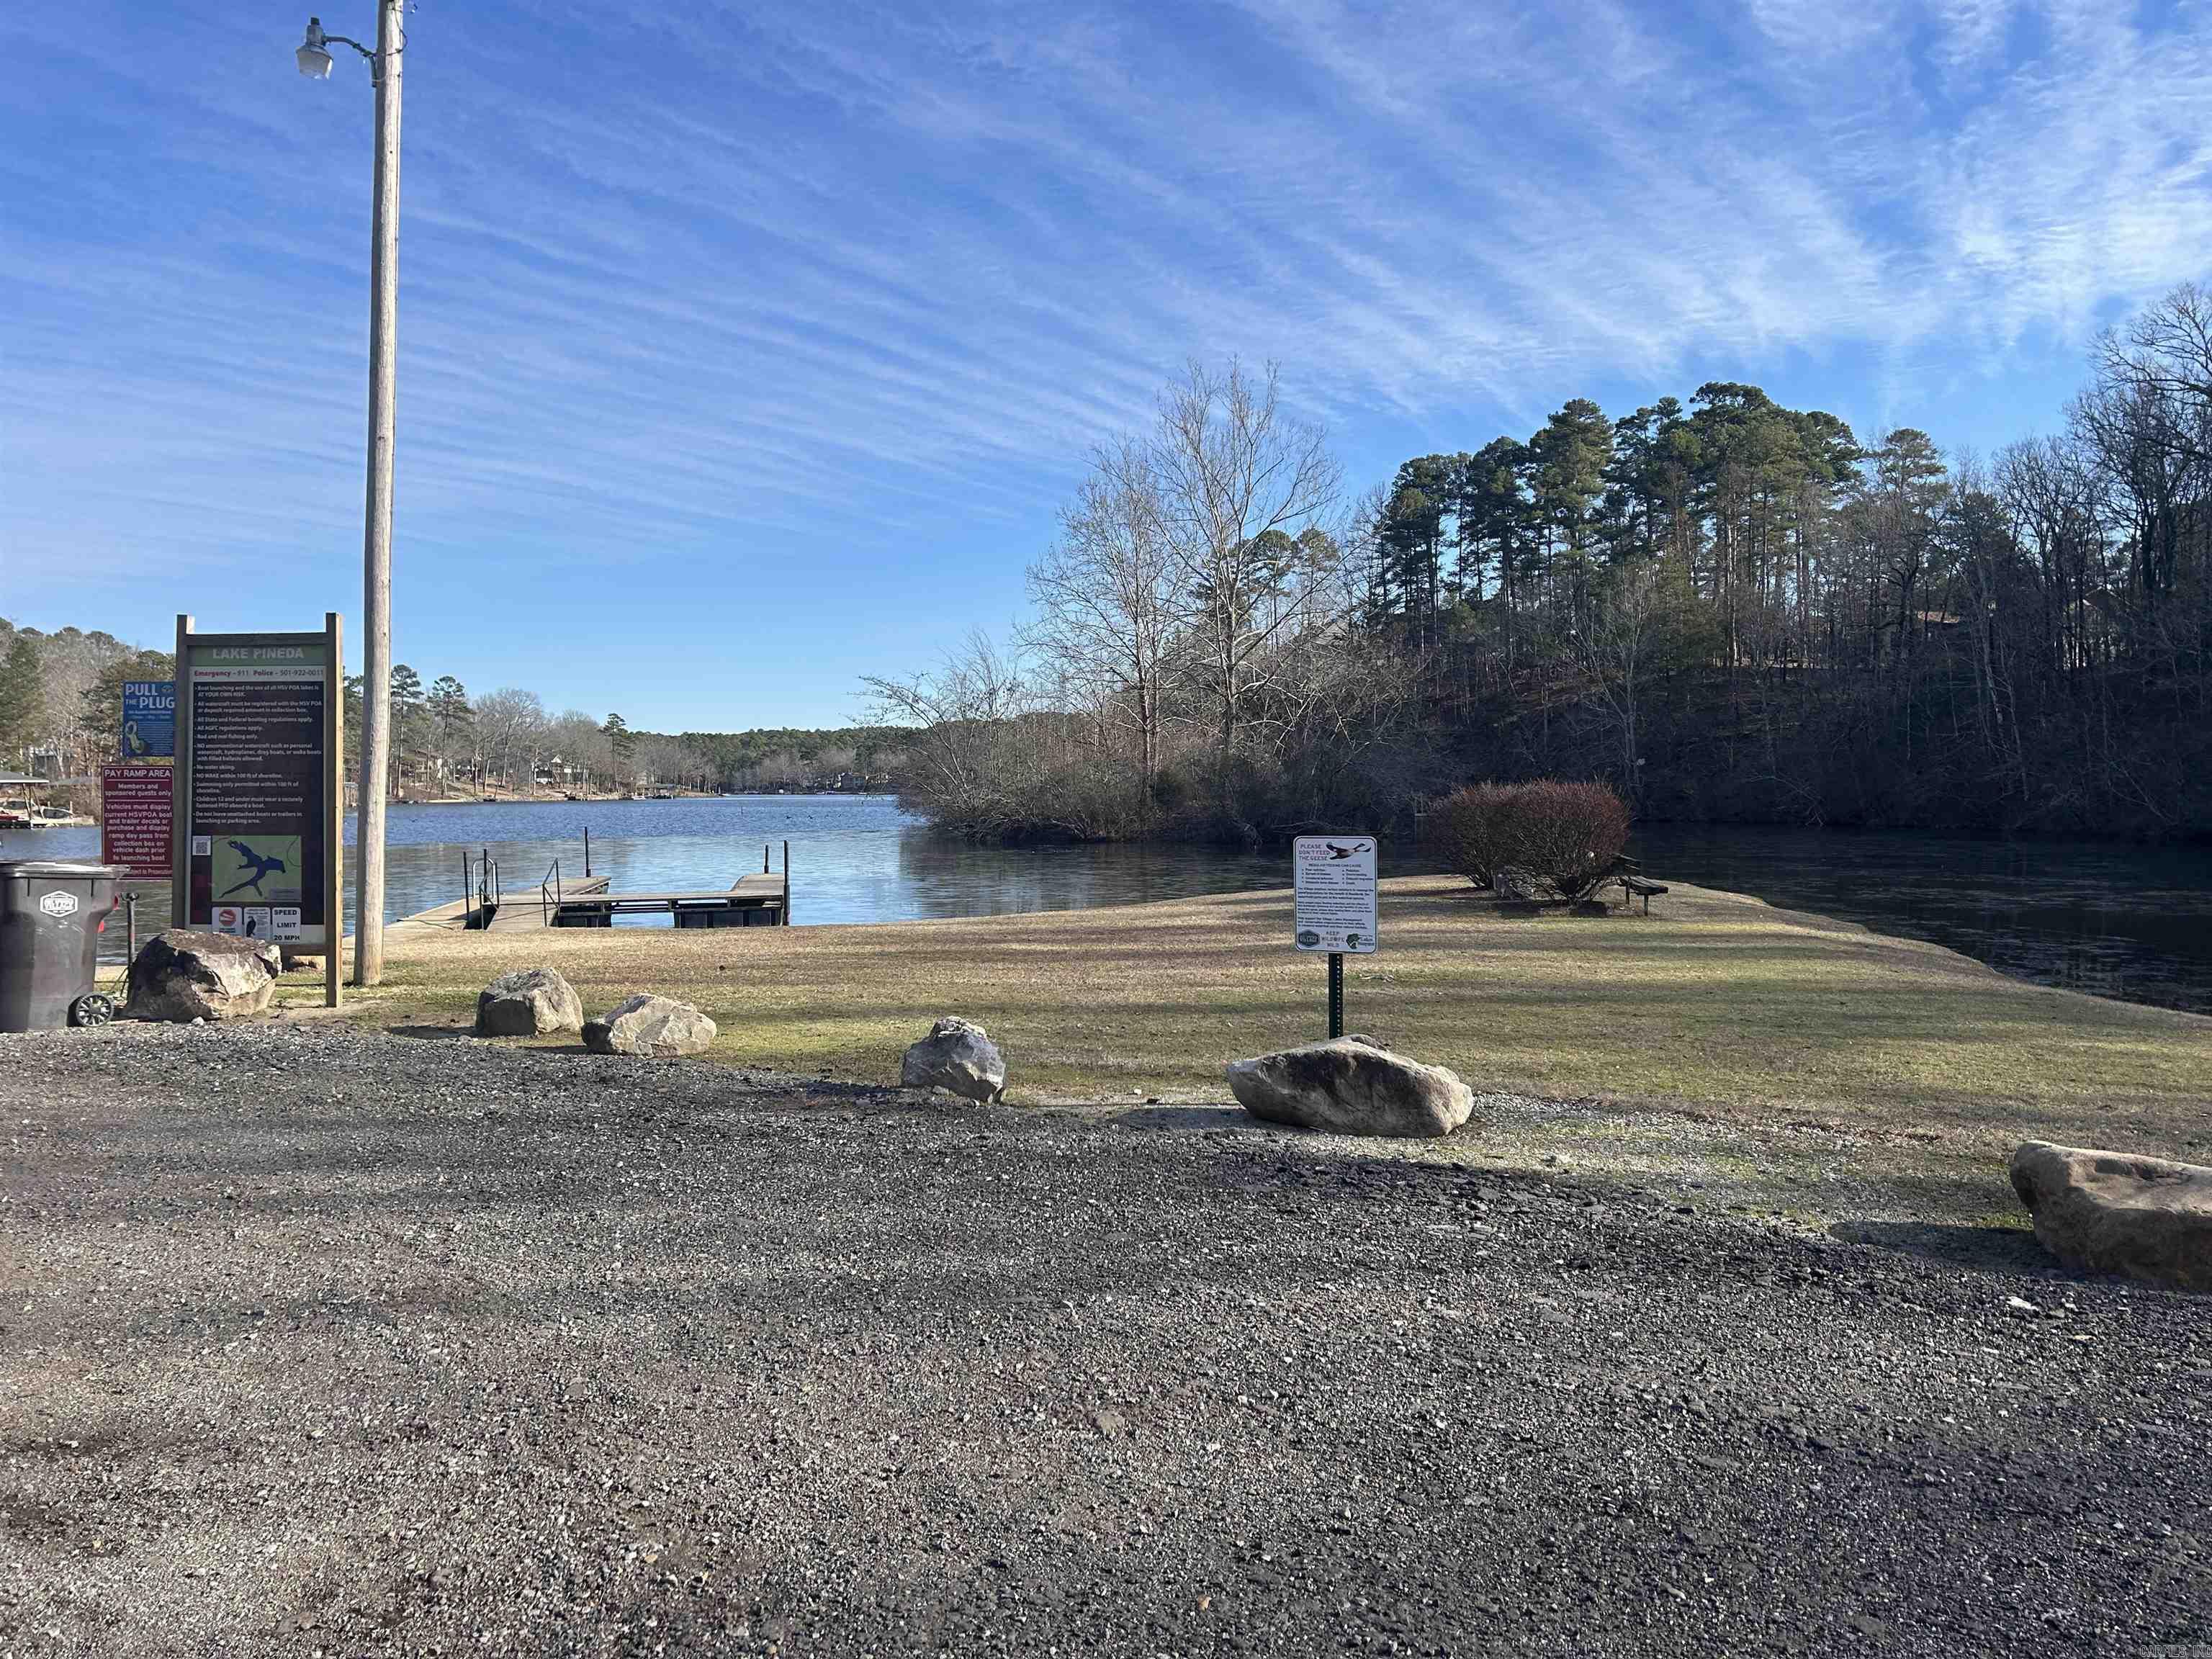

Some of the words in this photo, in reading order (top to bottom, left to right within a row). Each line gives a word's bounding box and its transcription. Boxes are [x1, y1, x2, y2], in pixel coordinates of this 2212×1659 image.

[212, 648, 248, 659] LAKE
[253, 648, 304, 659] PINEDA
[126, 684, 158, 696] PULL
[140, 697, 175, 709] PLUG
